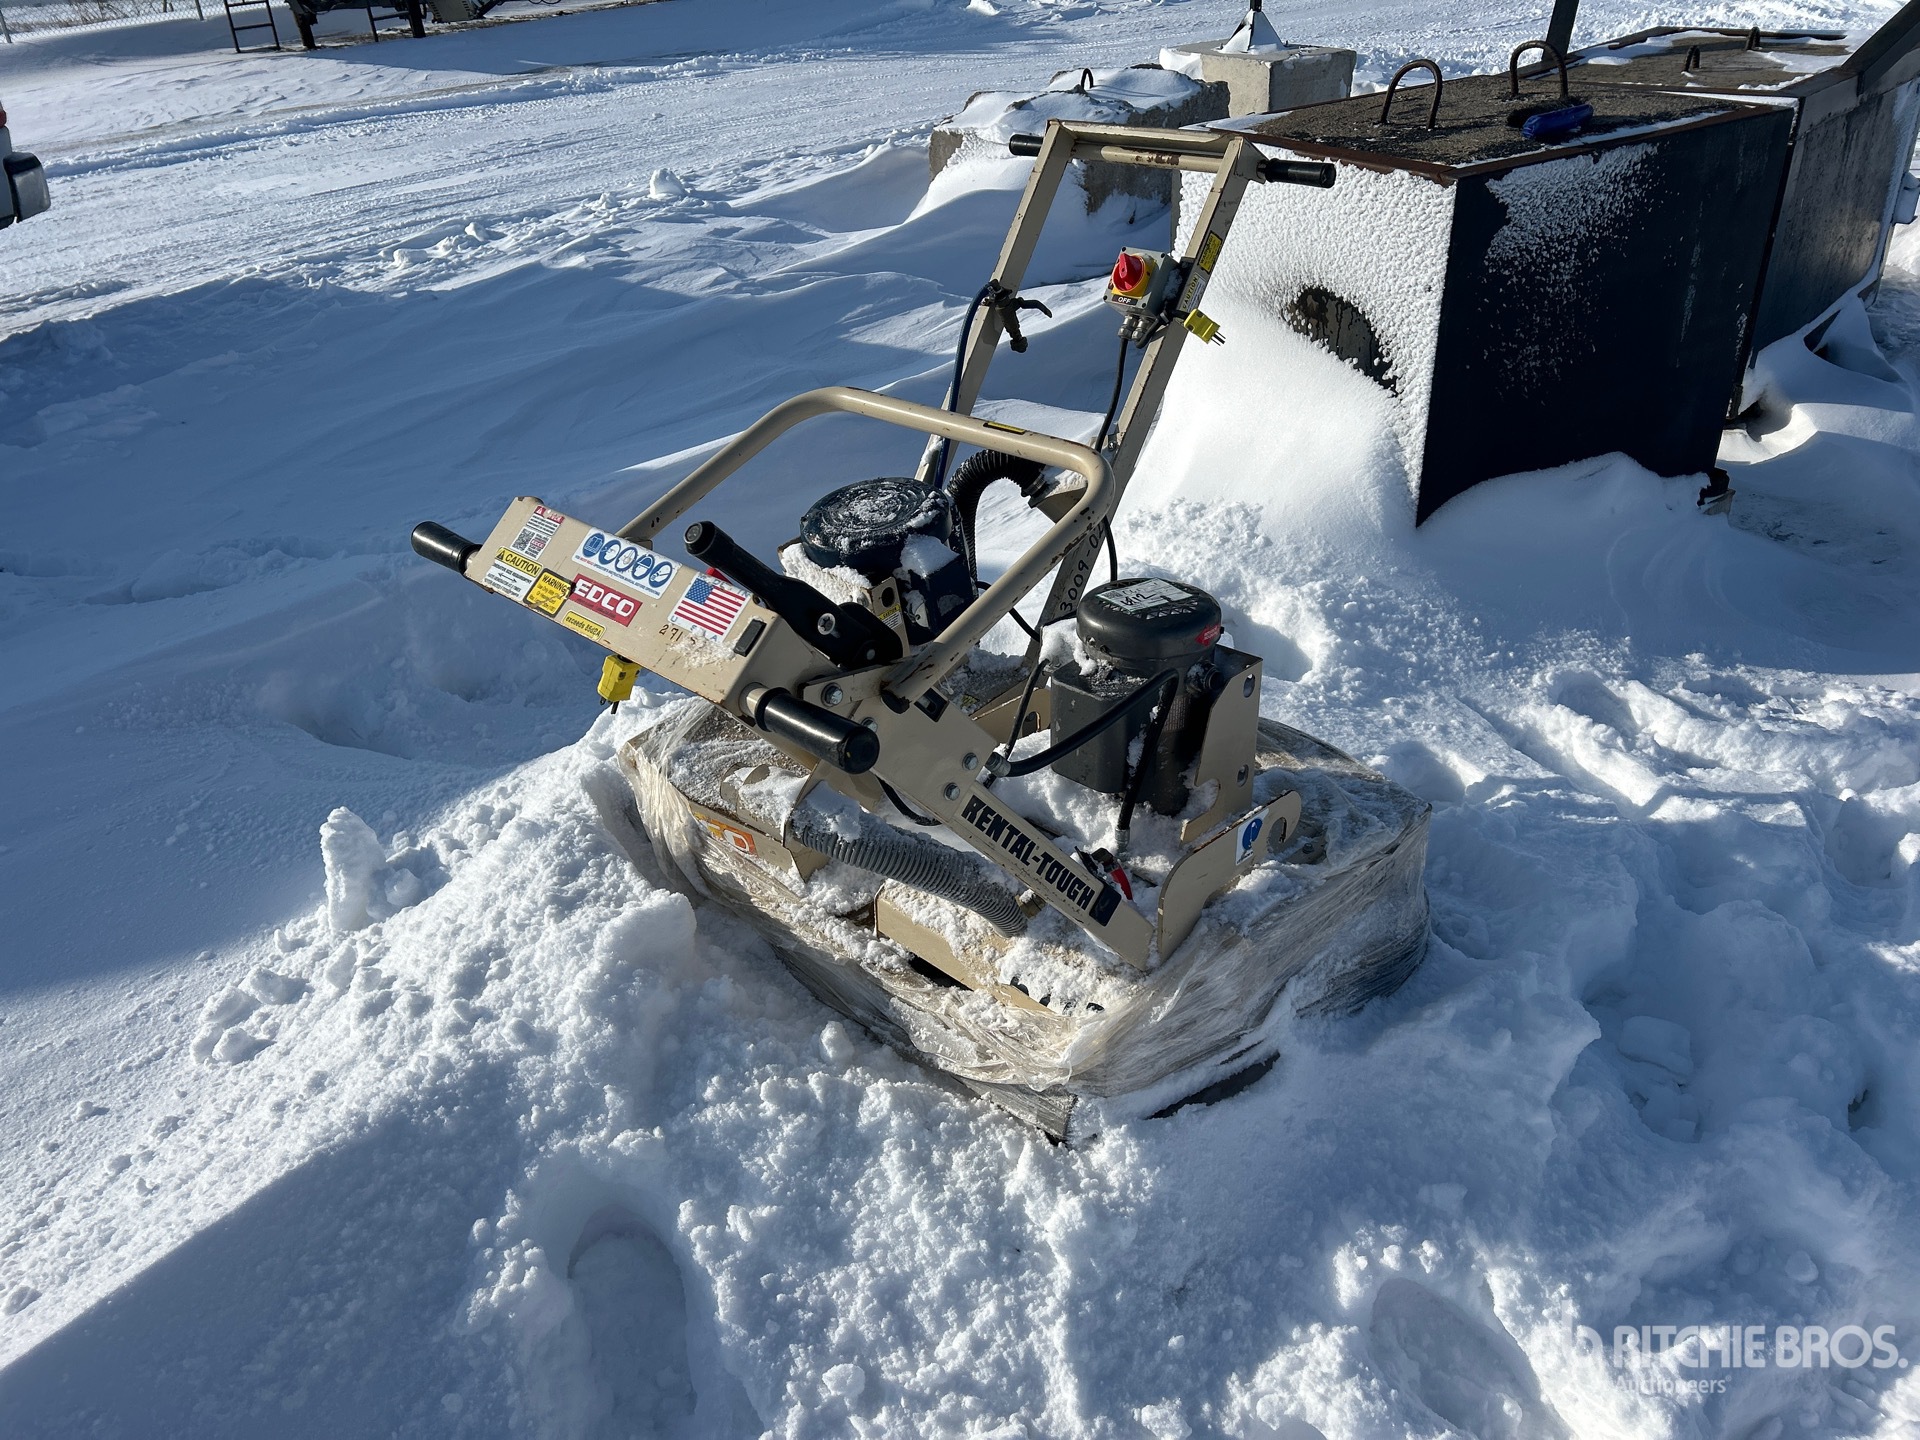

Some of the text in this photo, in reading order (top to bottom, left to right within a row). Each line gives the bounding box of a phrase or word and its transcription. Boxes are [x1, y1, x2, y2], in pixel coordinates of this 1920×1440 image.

[1117, 296, 1132, 304] OFF
[1182, 276, 1199, 310] CAUTION
[505, 553, 540, 576] CAUTION
[574, 578, 635, 617] EDCO
[961, 794, 1096, 911] RENTAL-TOUGH
